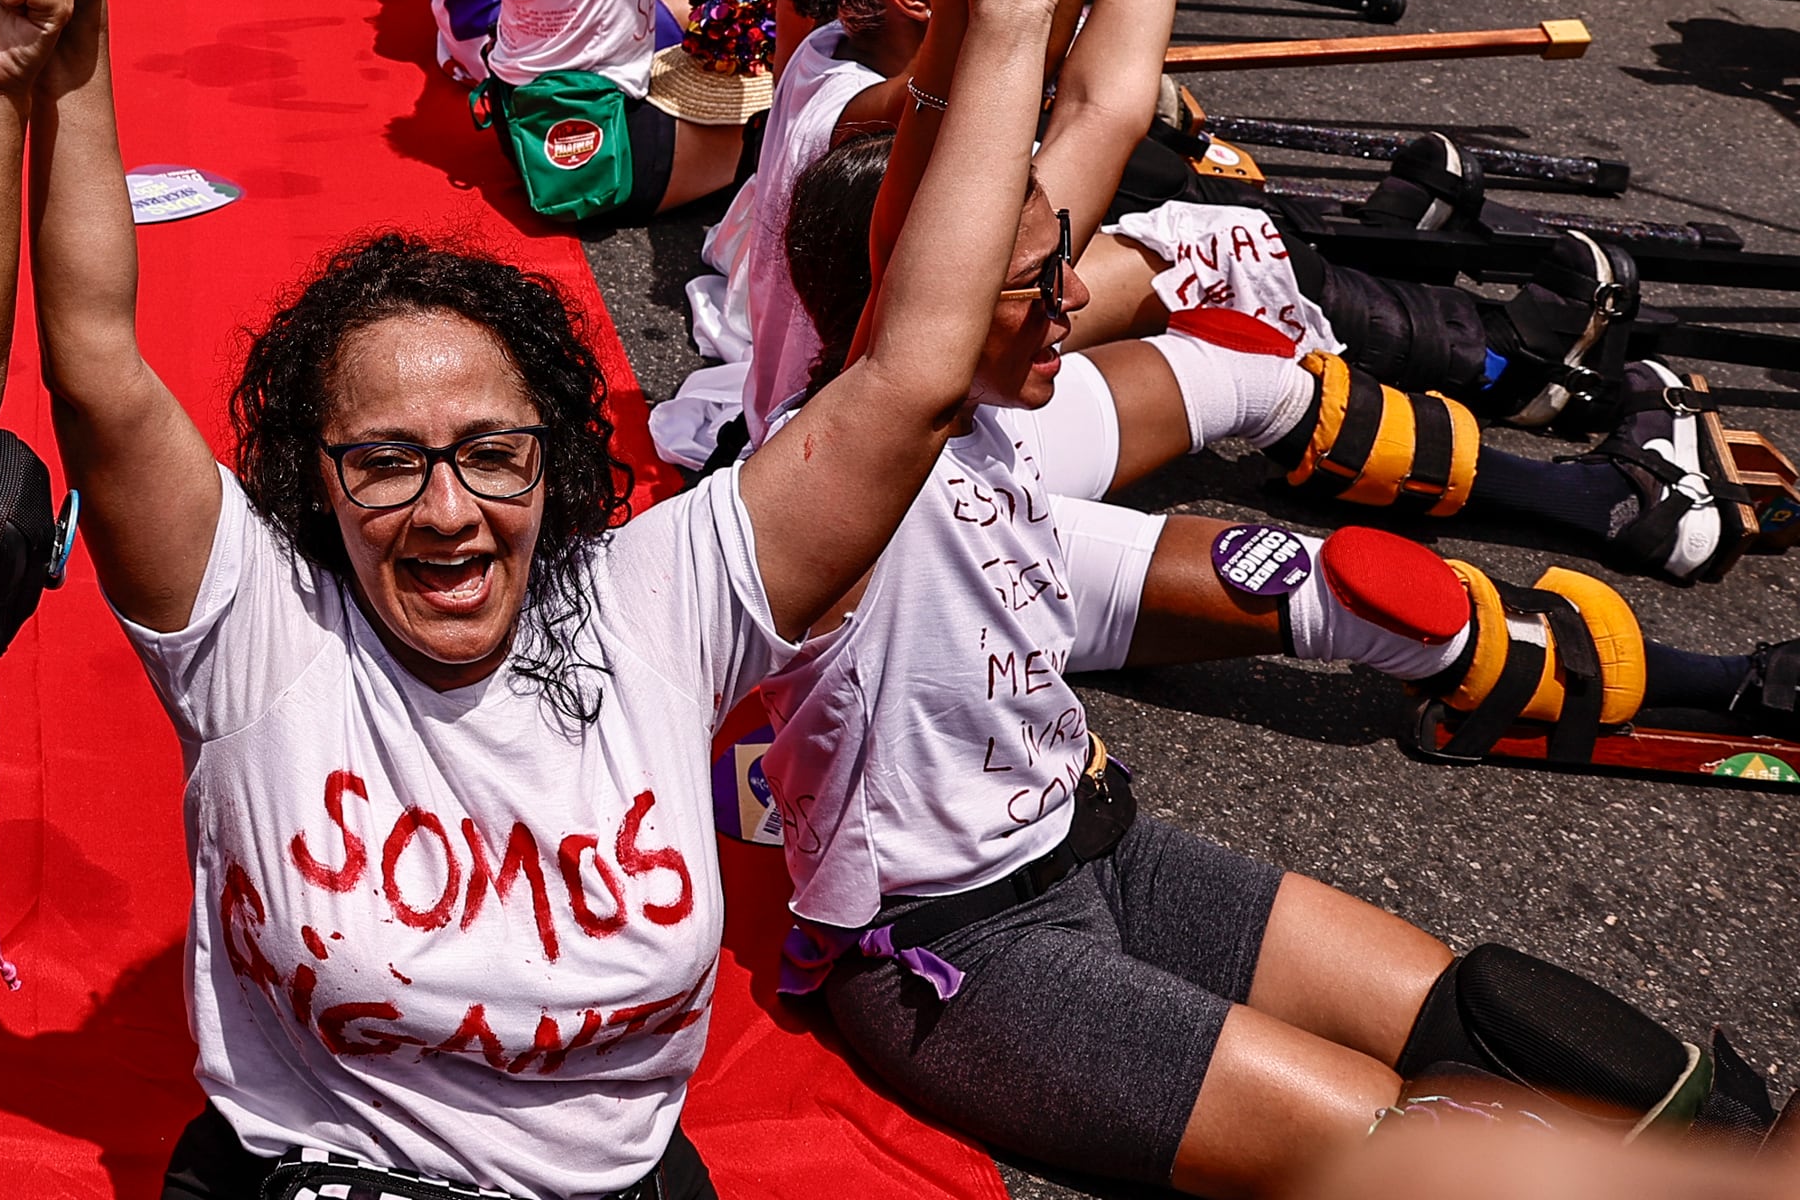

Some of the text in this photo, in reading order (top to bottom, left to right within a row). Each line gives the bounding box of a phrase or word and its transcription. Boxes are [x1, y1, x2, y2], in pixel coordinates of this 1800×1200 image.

[1229, 531, 1287, 583] COMIGO
[1245, 538, 1301, 591] NÃO MEXE
[290, 778, 693, 962] SOMOS
